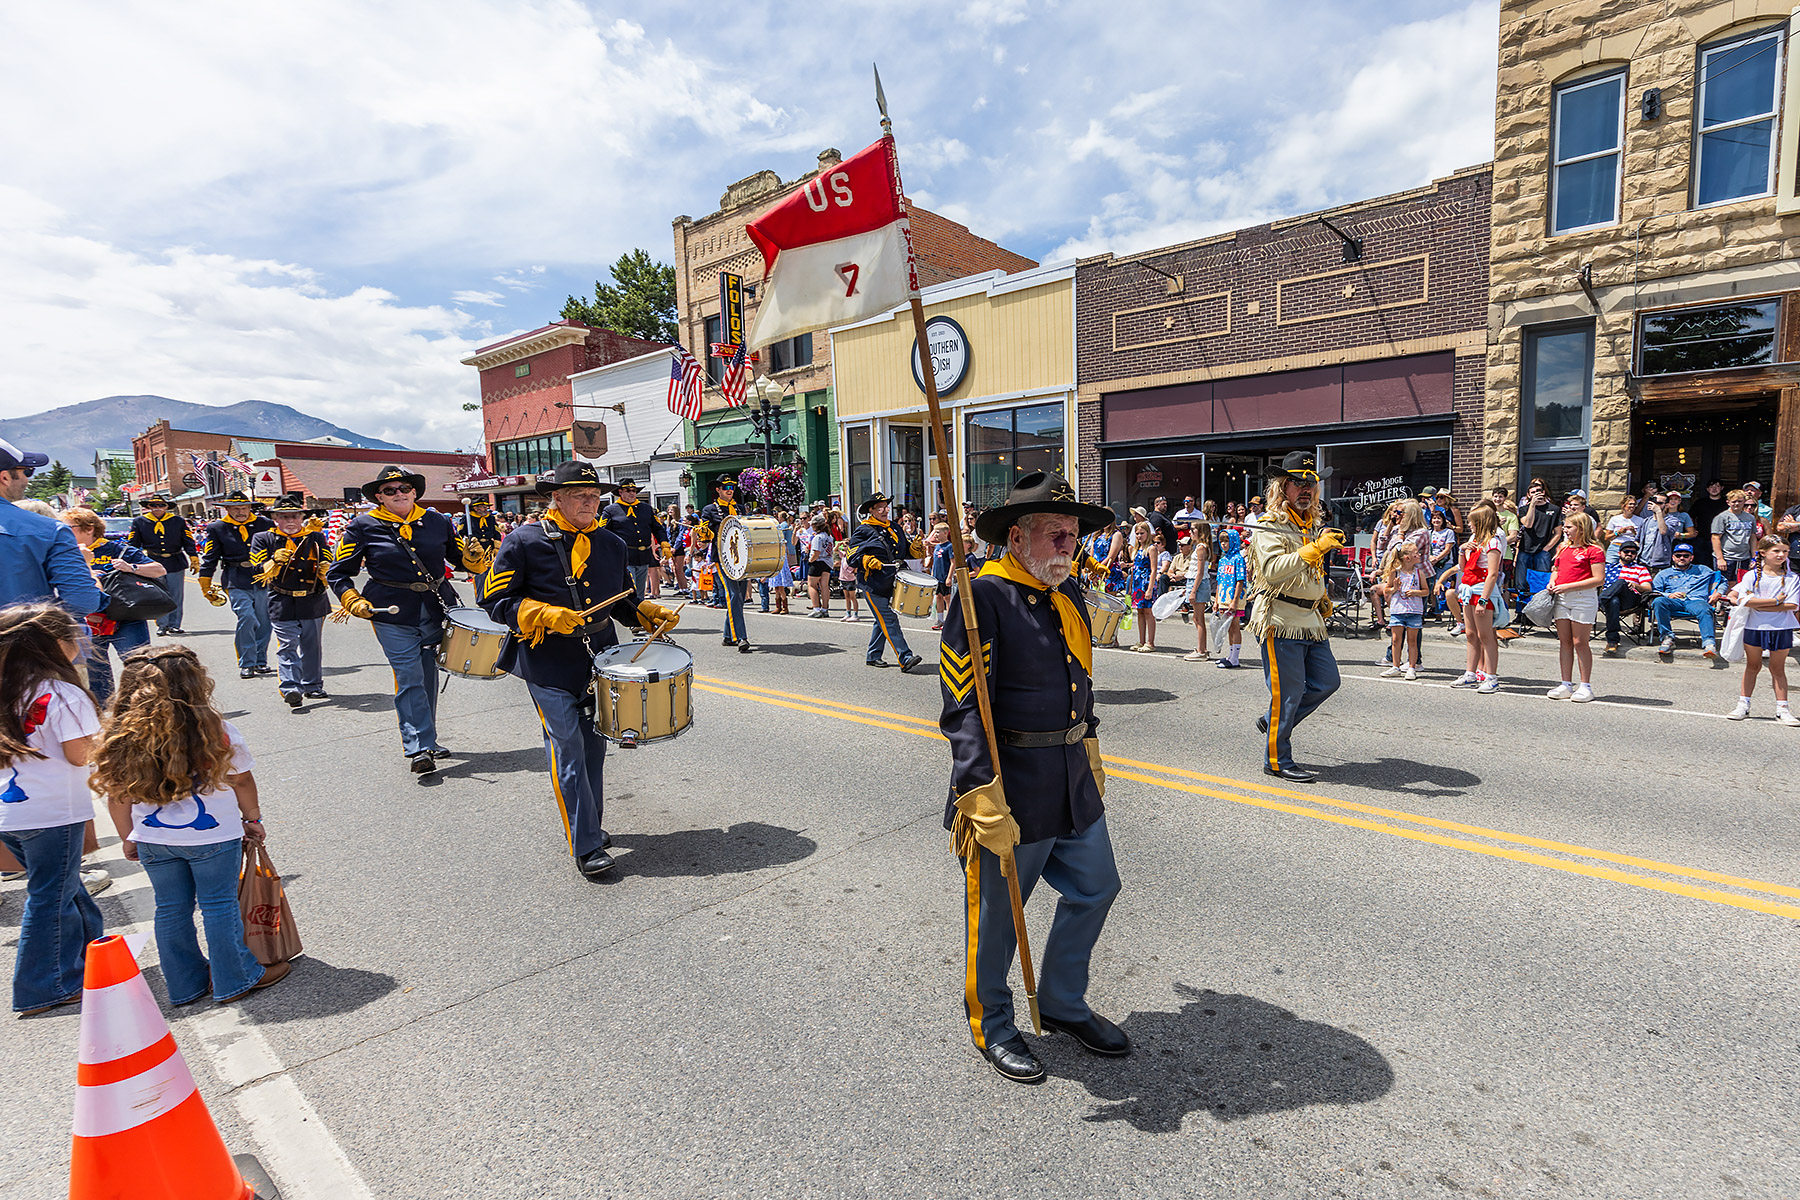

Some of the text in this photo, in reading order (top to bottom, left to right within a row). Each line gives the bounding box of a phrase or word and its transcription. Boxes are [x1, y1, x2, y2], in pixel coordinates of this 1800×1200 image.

[803, 171, 854, 212] US
[902, 228, 919, 291] WYOMING
[841, 263, 860, 297] 7
[728, 275, 742, 344] FOLOS
[929, 339, 959, 355] OUTHERN
[675, 450, 694, 458] FOSTER
